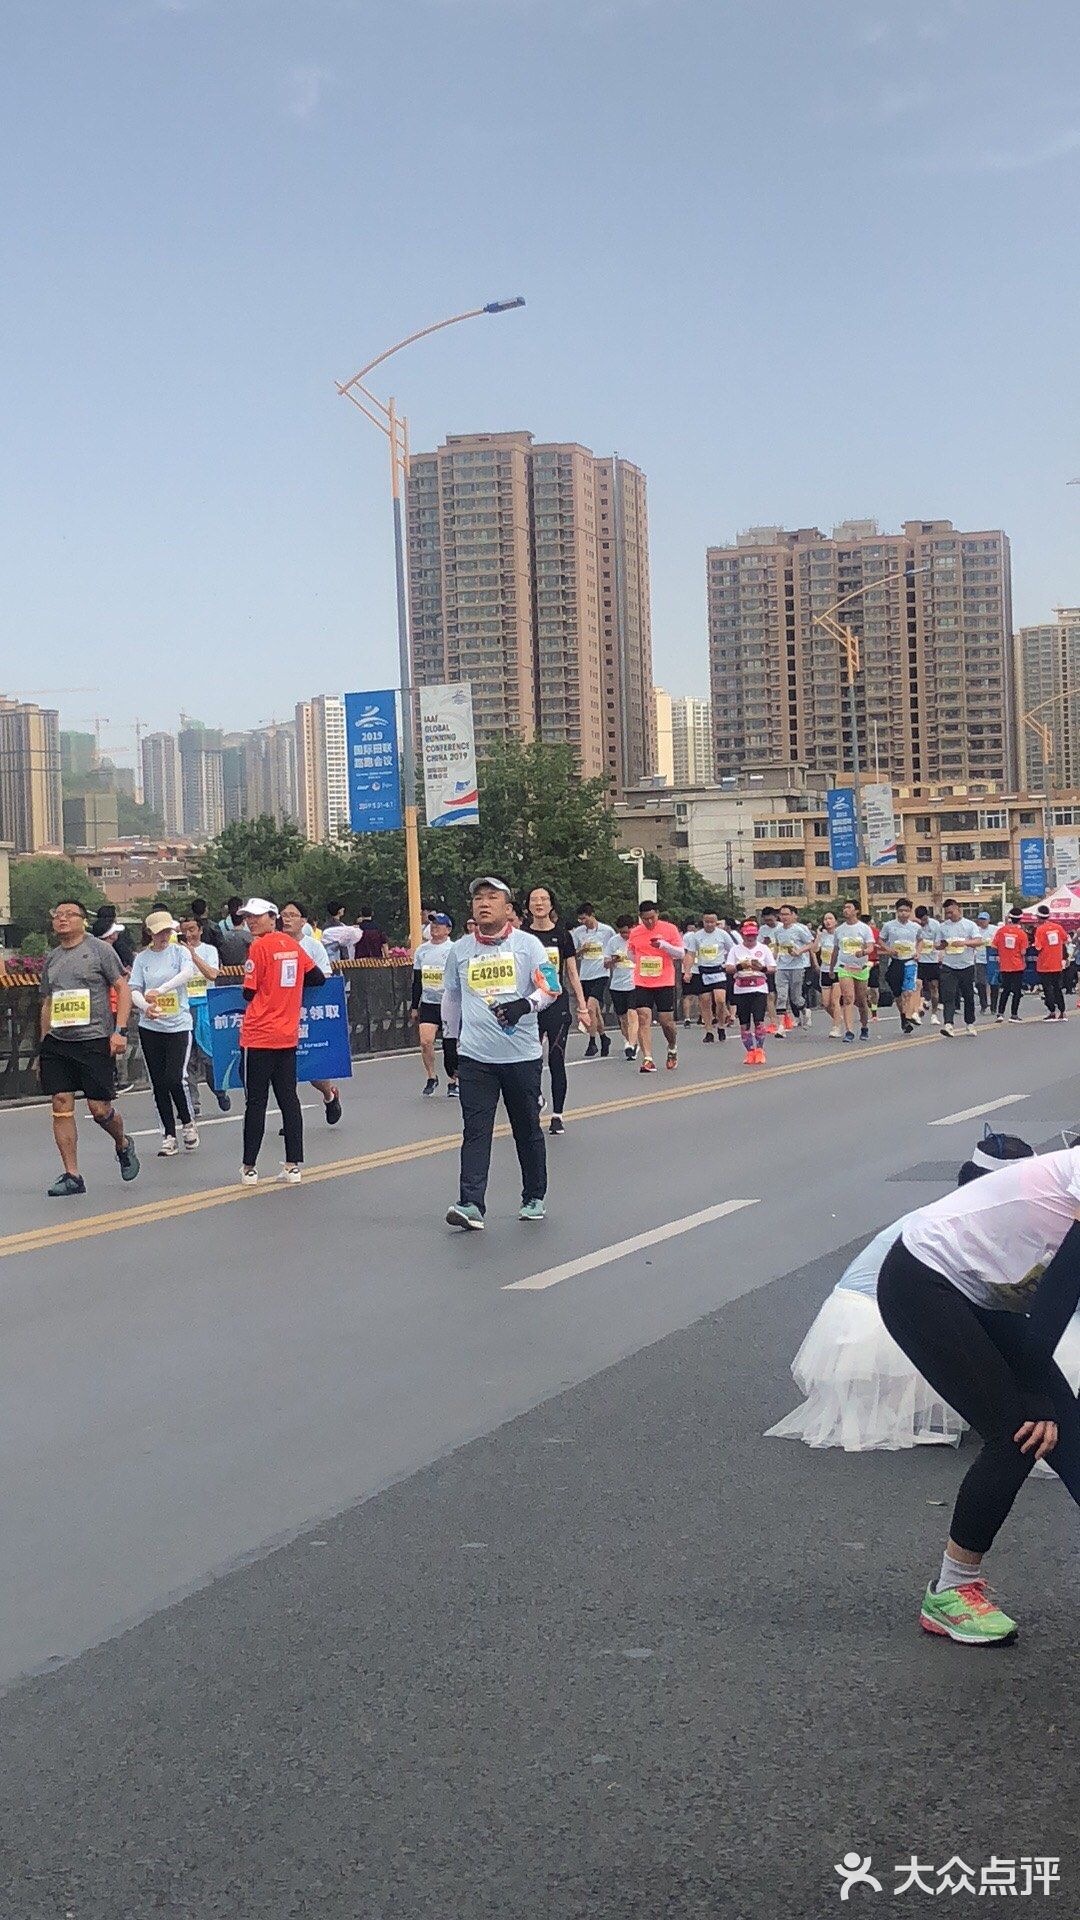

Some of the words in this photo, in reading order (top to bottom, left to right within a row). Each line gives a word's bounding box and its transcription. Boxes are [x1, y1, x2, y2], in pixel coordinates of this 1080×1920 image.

[361, 731, 383, 742] 2019
[353, 742, 393, 756] 国际田联
[450, 752, 468, 761] 2019
[471, 965, 514, 981] E42983
[54, 1001, 86, 1013] E44754
